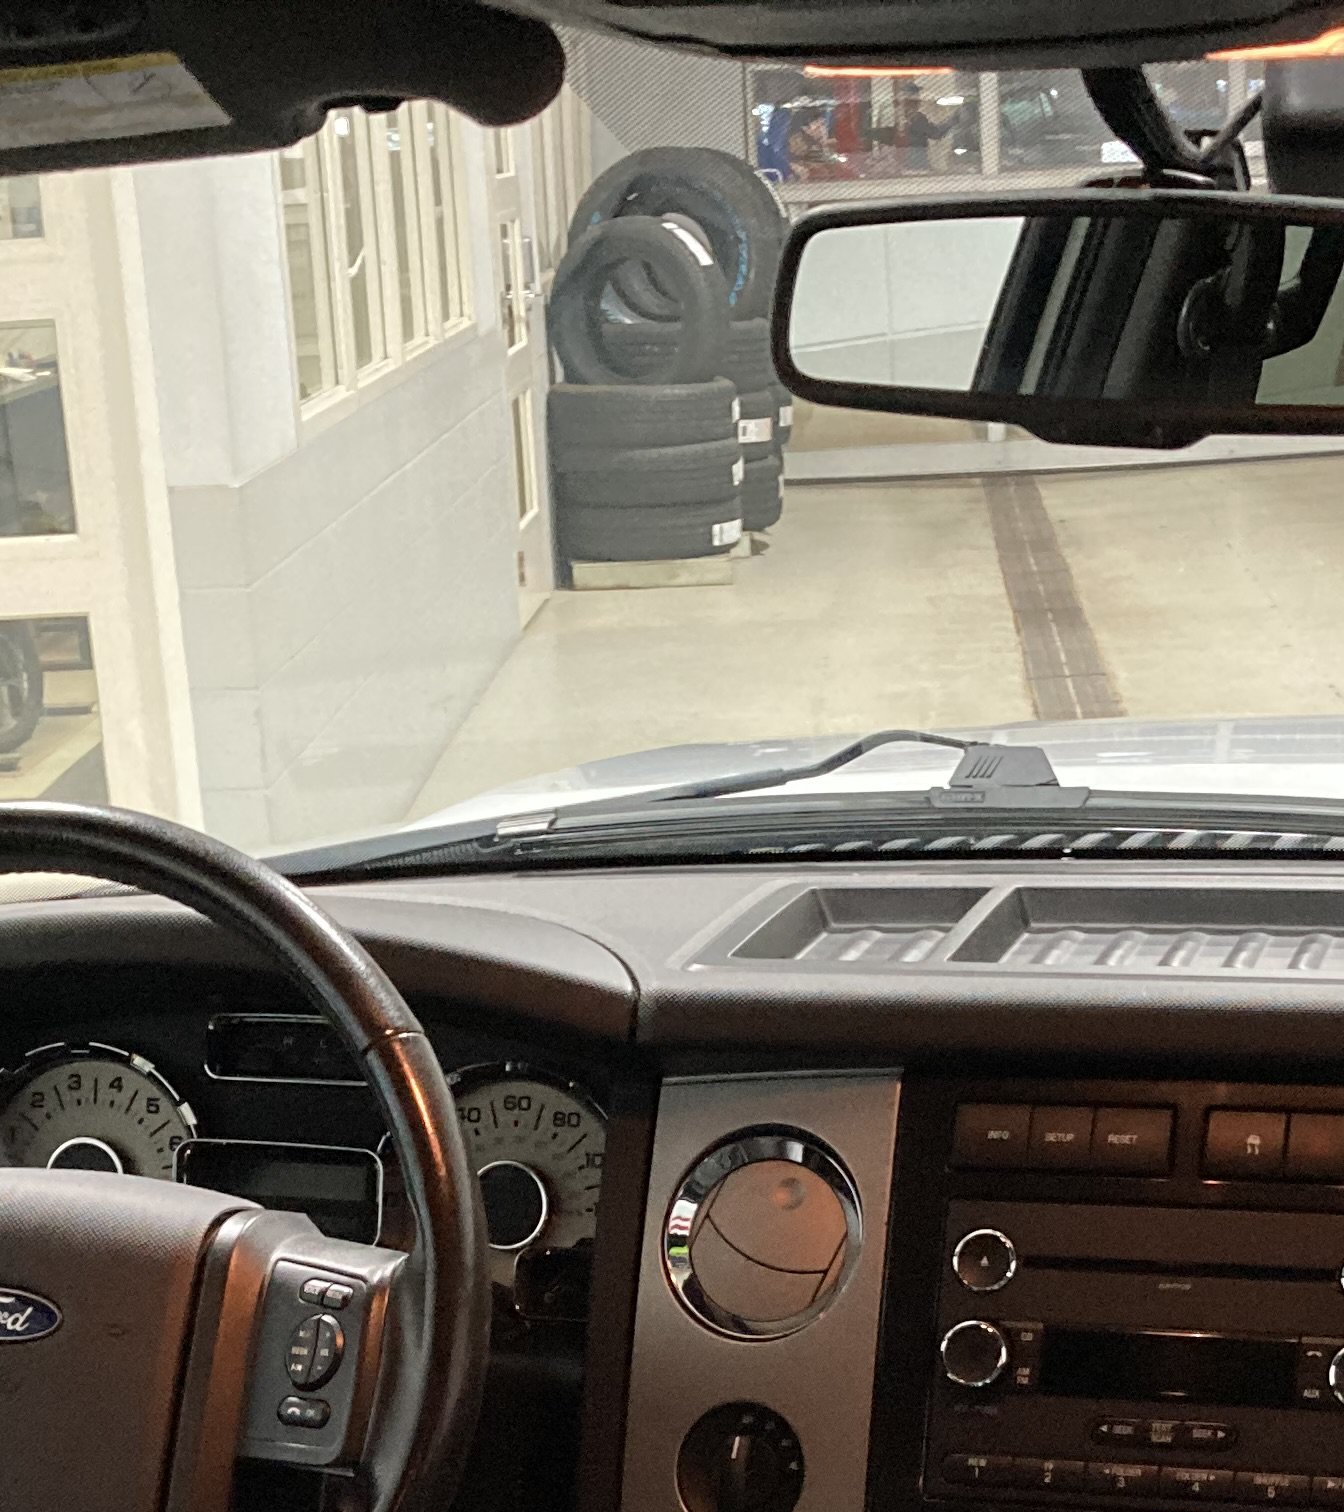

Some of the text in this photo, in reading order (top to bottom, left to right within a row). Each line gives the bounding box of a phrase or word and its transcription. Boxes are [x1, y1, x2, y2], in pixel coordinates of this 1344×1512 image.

[68, 1074, 82, 1091] 3
[109, 1076, 124, 1092] 4
[30, 1092, 45, 1108] 2
[146, 1098, 161, 1114] 5
[503, 1095, 532, 1112] 60
[552, 1112, 581, 1128] 80
[987, 1130, 1138, 1144] INFO SETUP RESET
[585, 1153, 604, 1169] 10
